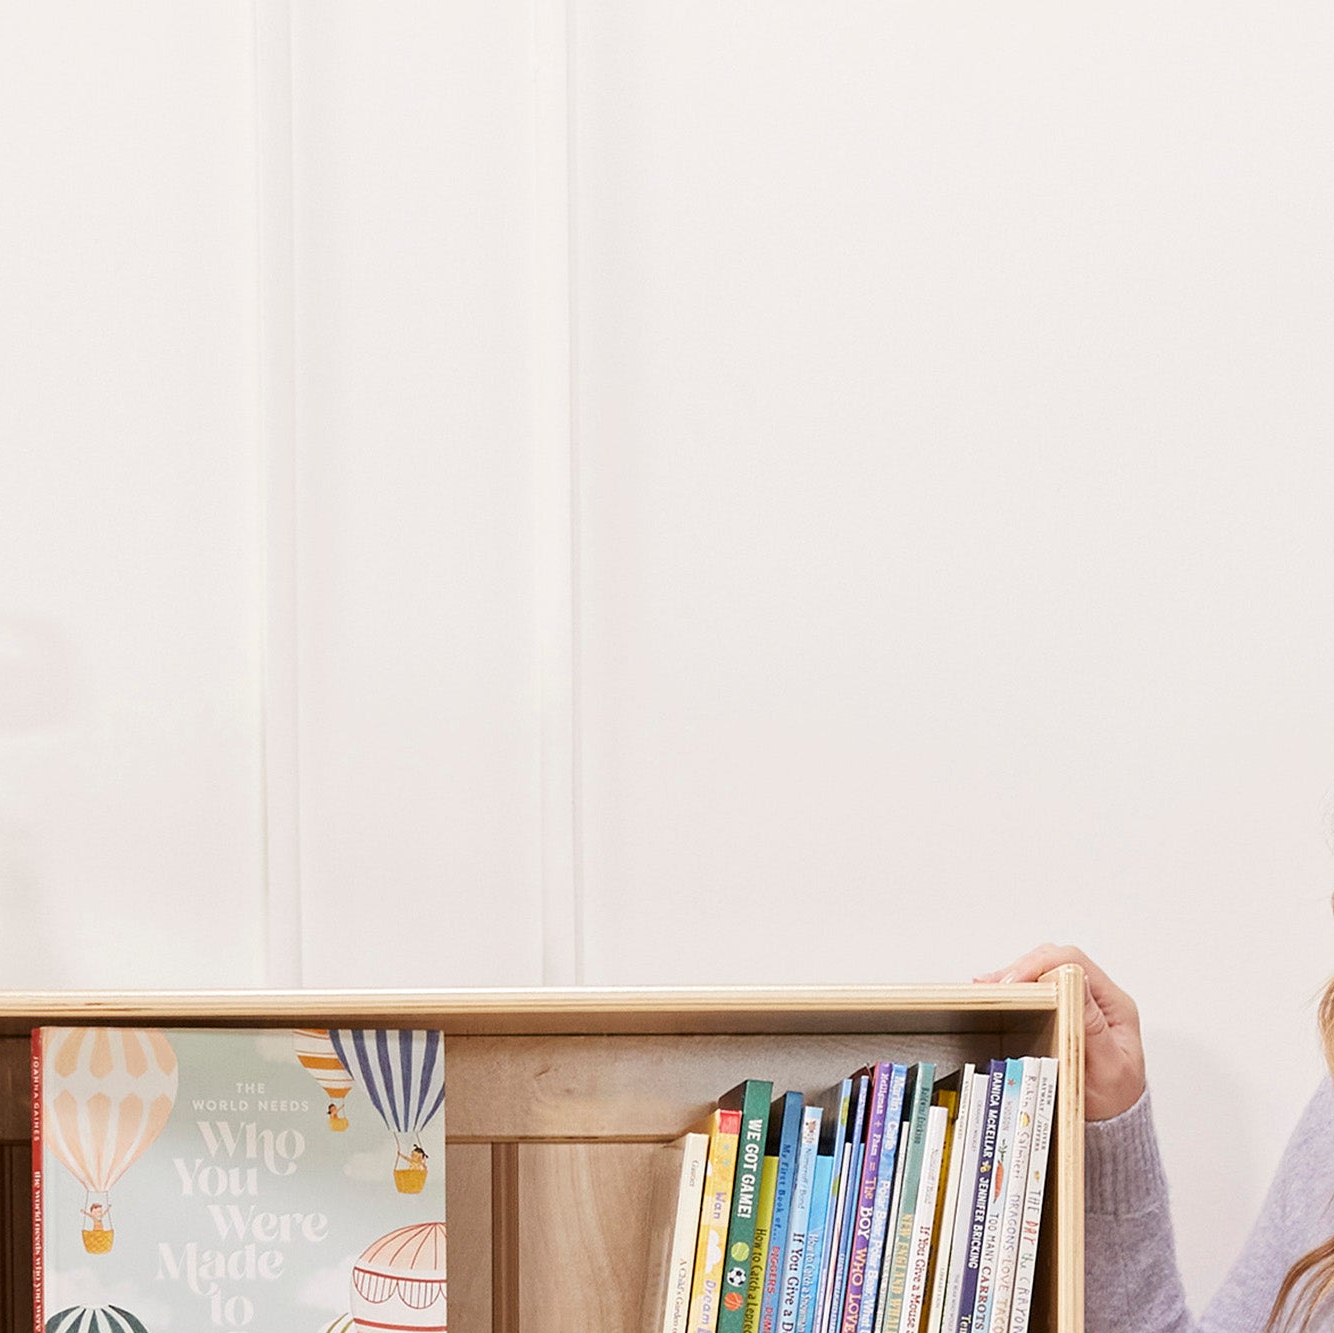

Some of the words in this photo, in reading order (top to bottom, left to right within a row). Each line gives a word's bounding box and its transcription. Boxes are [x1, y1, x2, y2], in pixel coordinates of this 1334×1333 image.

[237, 1083, 265, 1093] THE
[988, 1072, 1003, 1106] DANICA
[192, 1100, 249, 1111] WORLD
[258, 1100, 308, 1111] NEEDS
[745, 1118, 762, 1140] WE
[982, 1109, 998, 1157] McKELLAR
[197, 1121, 305, 1175] Who
[742, 1143, 759, 1172] GOT
[172, 1158, 258, 1196] You
[863, 1176, 876, 1198] The
[713, 1192, 726, 1219] Wan
[736, 1174, 755, 1217] GAME!
[973, 1177, 989, 1222] JENNIFER
[1025, 1189, 1040, 1211] THE
[207, 1204, 328, 1241] Were
[856, 1206, 873, 1239] BOY
[918, 1226, 930, 1236] If
[986, 1213, 999, 1231] TOO
[1002, 1194, 1020, 1250] DRAGONS
[1021, 1219, 1037, 1244] DAY
[753, 1229, 766, 1247] How
[791, 1232, 804, 1244] If
[916, 1238, 928, 1255] You
[967, 1224, 983, 1268] BRICKING
[982, 1235, 996, 1261] MANY
[157, 1243, 283, 1295] Made
[751, 1252, 764, 1262] to
[788, 1248, 802, 1270] You
[849, 1247, 866, 1285] WHO
[912, 1259, 925, 1281] Give
[1019, 1252, 1033, 1268] the
[748, 1265, 762, 1291] Catch
[997, 1258, 1013, 1291] LOVE
[700, 1279, 717, 1324] Dream
[784, 1276, 799, 1305] Give
[974, 1266, 992, 1329] CARROTS
[211, 1289, 255, 1327] to
[906, 1293, 921, 1327] Mouse
[957, 1314, 971, 1333] Ten
